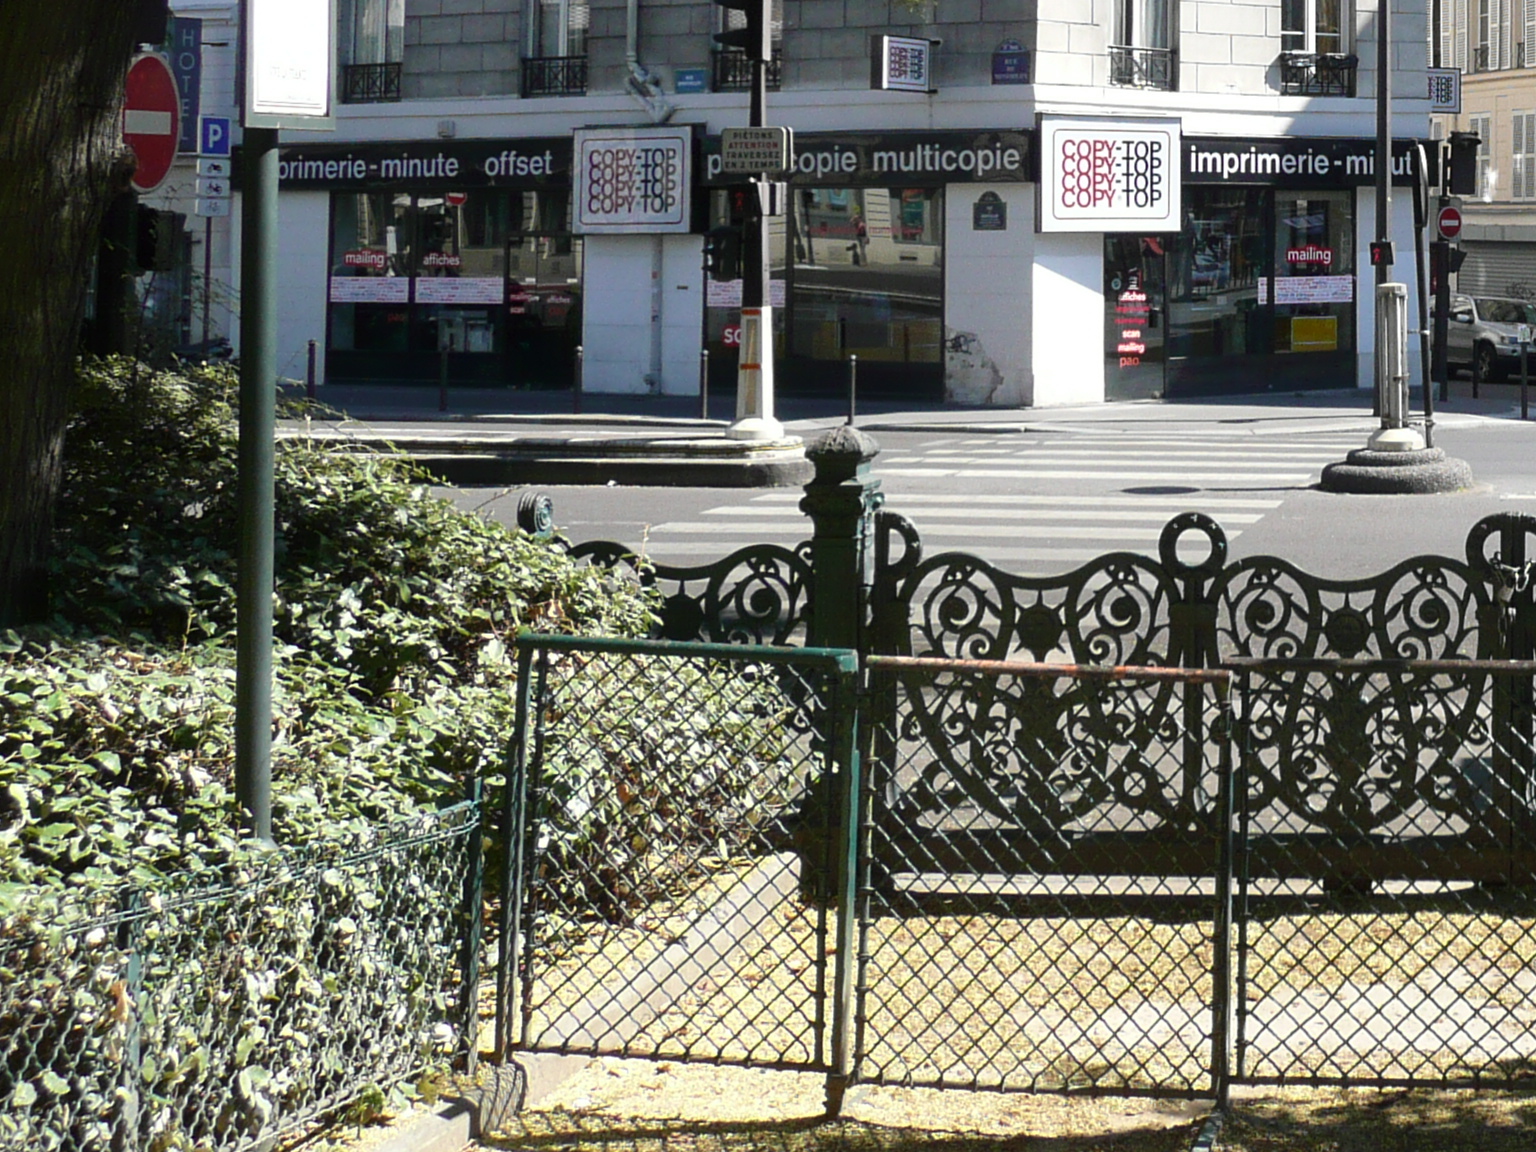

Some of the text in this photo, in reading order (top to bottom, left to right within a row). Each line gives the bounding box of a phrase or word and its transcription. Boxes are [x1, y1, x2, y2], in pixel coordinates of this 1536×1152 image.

[178, 28, 196, 141] HOTEL
[727, 141, 779, 149] ATTENTION
[1061, 139, 1163, 158] COPY-TOP
[484, 150, 553, 176] offset
[588, 148, 677, 167] COPY-TOP
[726, 151, 780, 159] TRAVERSEZ
[749, 160, 781, 168] TEMPS
[873, 142, 1020, 176] multicopie
[588, 164, 677, 182] COPY-TOP
[1061, 156, 1163, 175] COPY-TOP
[588, 180, 677, 197] COPY-TOP
[1061, 172, 1163, 191] COPY-TOP
[588, 195, 677, 214] COPY-TOP
[1061, 189, 1163, 208] COPY-TOP
[345, 251, 385, 267] mailing
[423, 252, 460, 266] affiches
[1287, 246, 1331, 264] mailing
[1122, 330, 1141, 339] scan
[1118, 342, 1145, 354] mailing
[1120, 357, 1139, 367] pao
